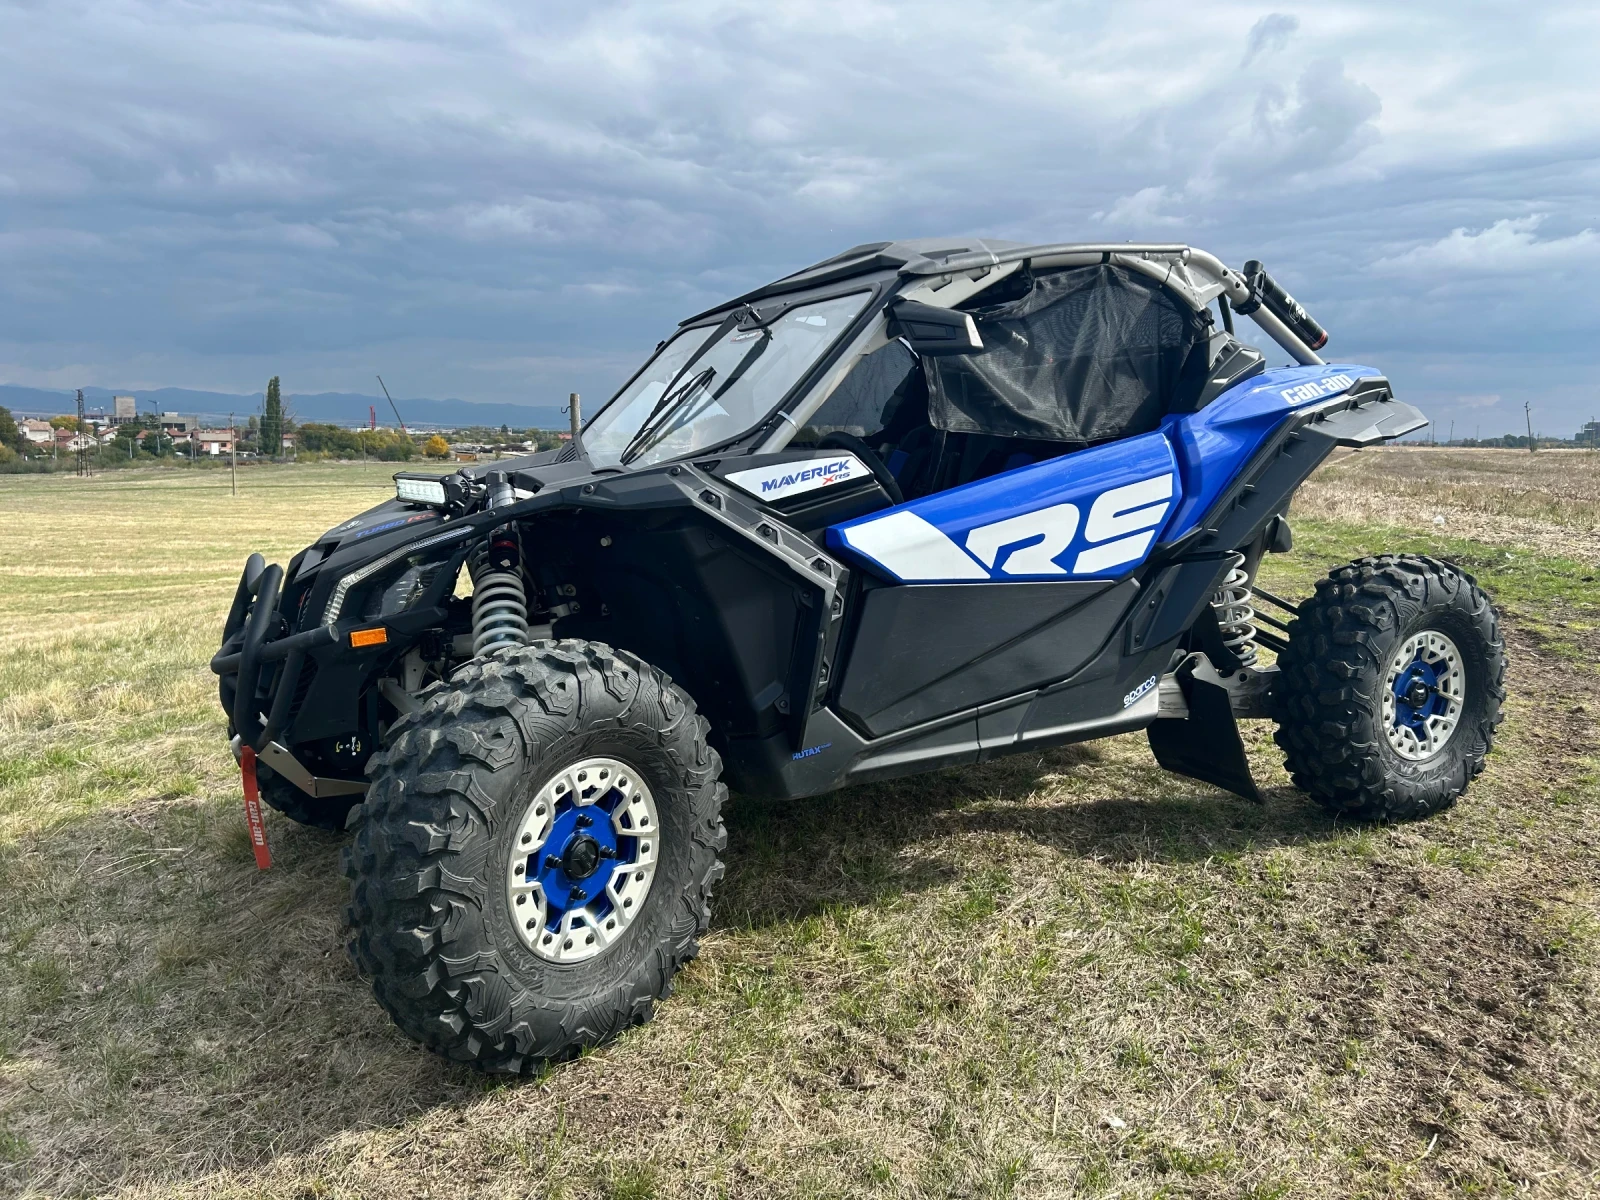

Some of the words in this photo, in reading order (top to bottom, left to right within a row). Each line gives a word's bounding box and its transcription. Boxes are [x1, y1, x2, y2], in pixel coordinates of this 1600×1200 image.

[1280, 373, 1354, 405] can-am
[761, 459, 851, 492] MAVERICK
[355, 519, 406, 539] TURBO
[965, 472, 1173, 575] RS
[248, 800, 264, 846] can-am
